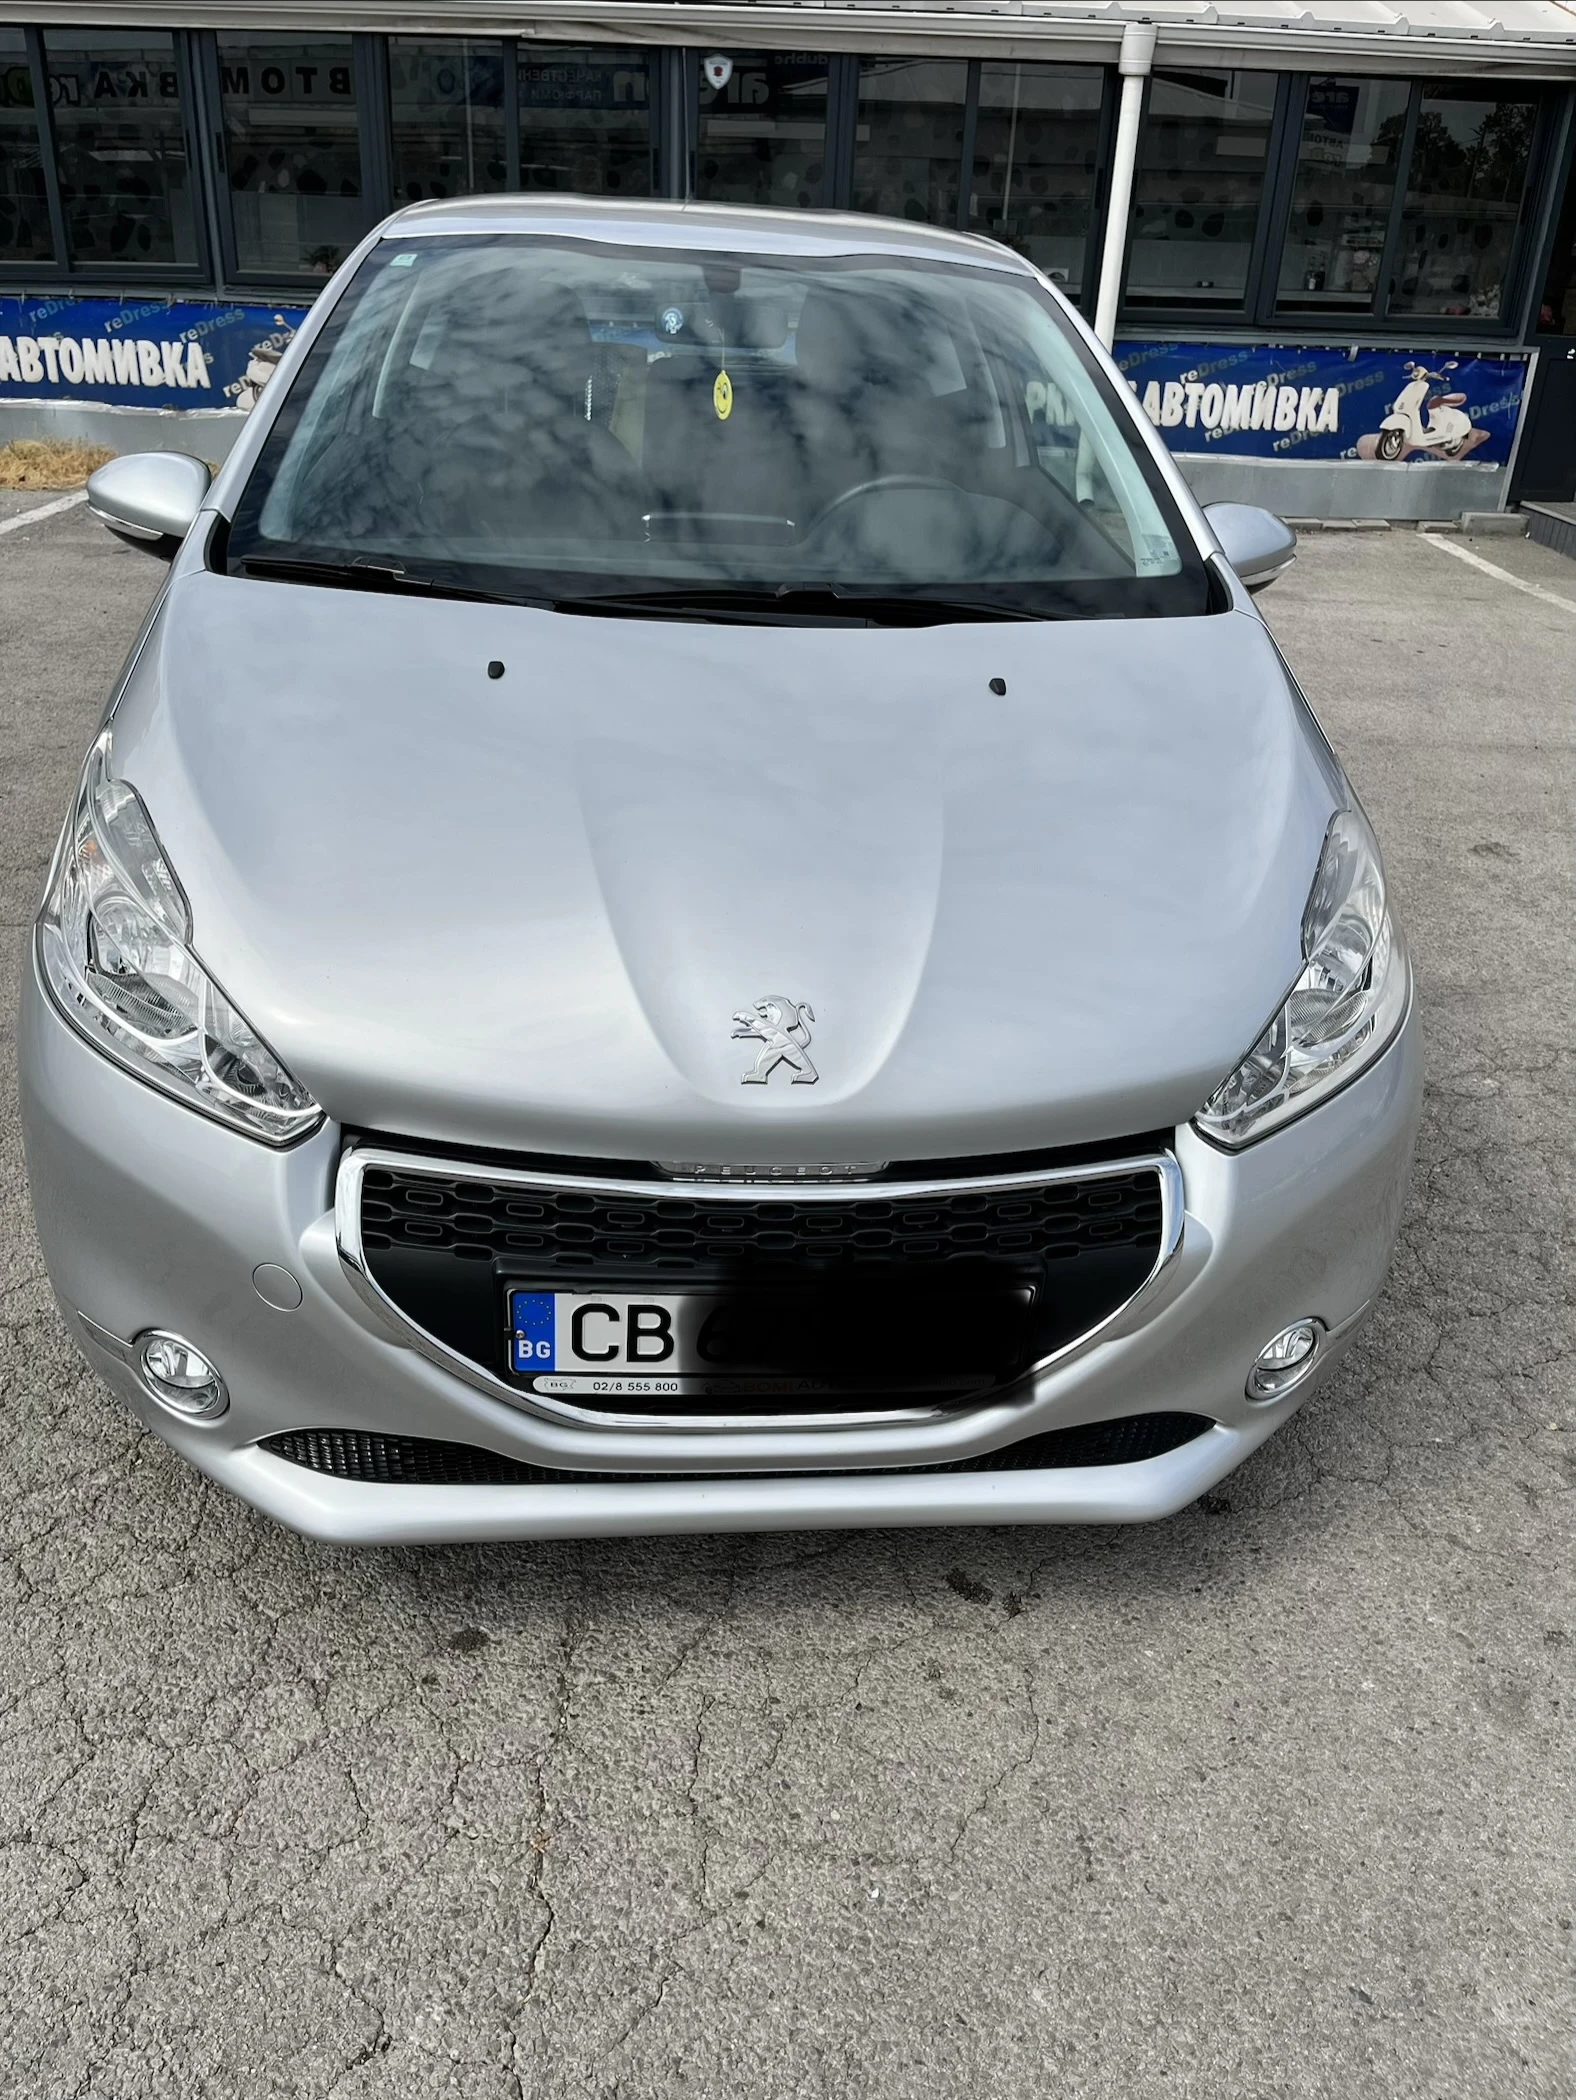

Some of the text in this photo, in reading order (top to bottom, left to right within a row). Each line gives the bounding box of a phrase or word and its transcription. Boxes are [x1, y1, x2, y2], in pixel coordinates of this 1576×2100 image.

[178, 307, 245, 344] reDress
[0, 336, 211, 389] АВТОМИВКА
[1179, 350, 1248, 384] reDress
[1142, 381, 1339, 432] АВТОМИВКА
[695, 1165, 856, 1175] PEUGEOT
[518, 1340, 551, 1359] BG
[571, 1303, 675, 1363] CB
[593, 1382, 678, 1391] 02/8 555 800
